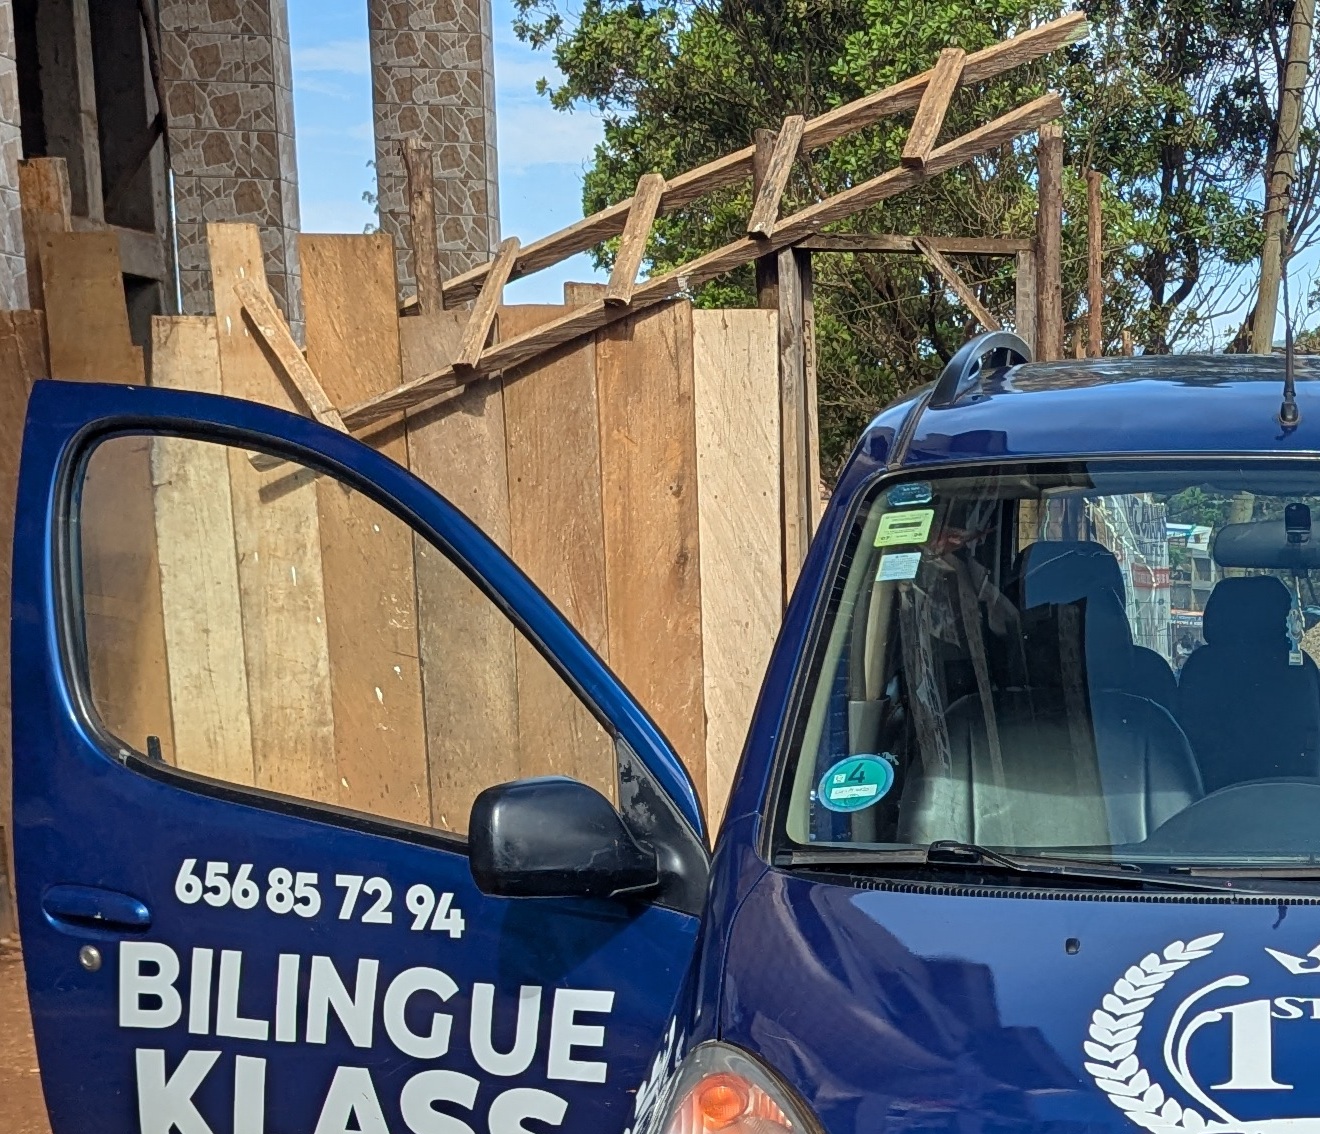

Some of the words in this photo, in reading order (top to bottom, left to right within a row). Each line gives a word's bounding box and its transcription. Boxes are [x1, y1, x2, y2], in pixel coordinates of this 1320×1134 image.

[848, 762, 866, 783] 4
[175, 858, 259, 909] 656
[266, 868, 321, 918] 85
[336, 874, 392, 925] 72
[405, 884, 465, 938] 94
[119, 941, 615, 1083] BILINGUE
